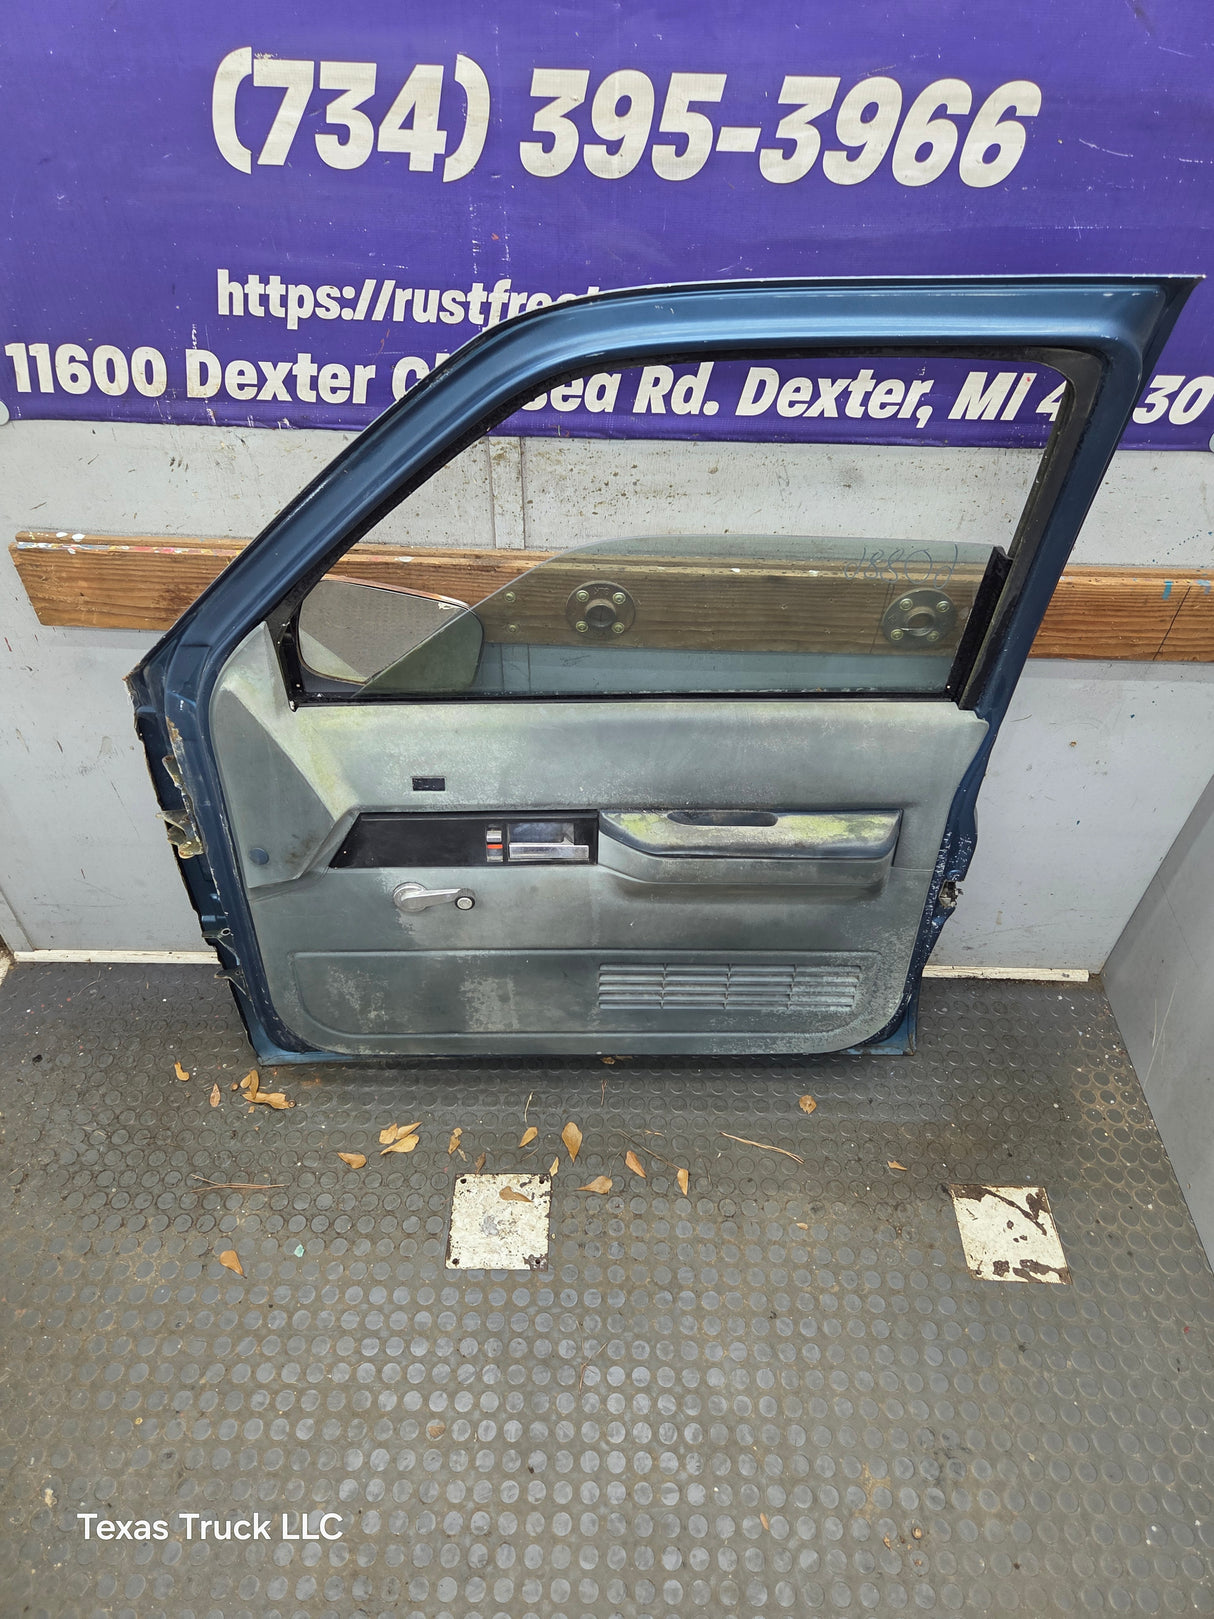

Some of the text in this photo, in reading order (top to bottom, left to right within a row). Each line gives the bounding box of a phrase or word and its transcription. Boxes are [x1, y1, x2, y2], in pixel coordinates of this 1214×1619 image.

[212, 46, 1042, 188] (734) 395-3966
[217, 269, 600, 332] https://rustfr
[5, 343, 167, 397] 11600
[185, 349, 376, 404] Dexter
[633, 362, 719, 417] Rd.
[735, 367, 934, 429] Dexter,
[948, 372, 1037, 421] MI
[1036, 375, 1214, 426] 430
